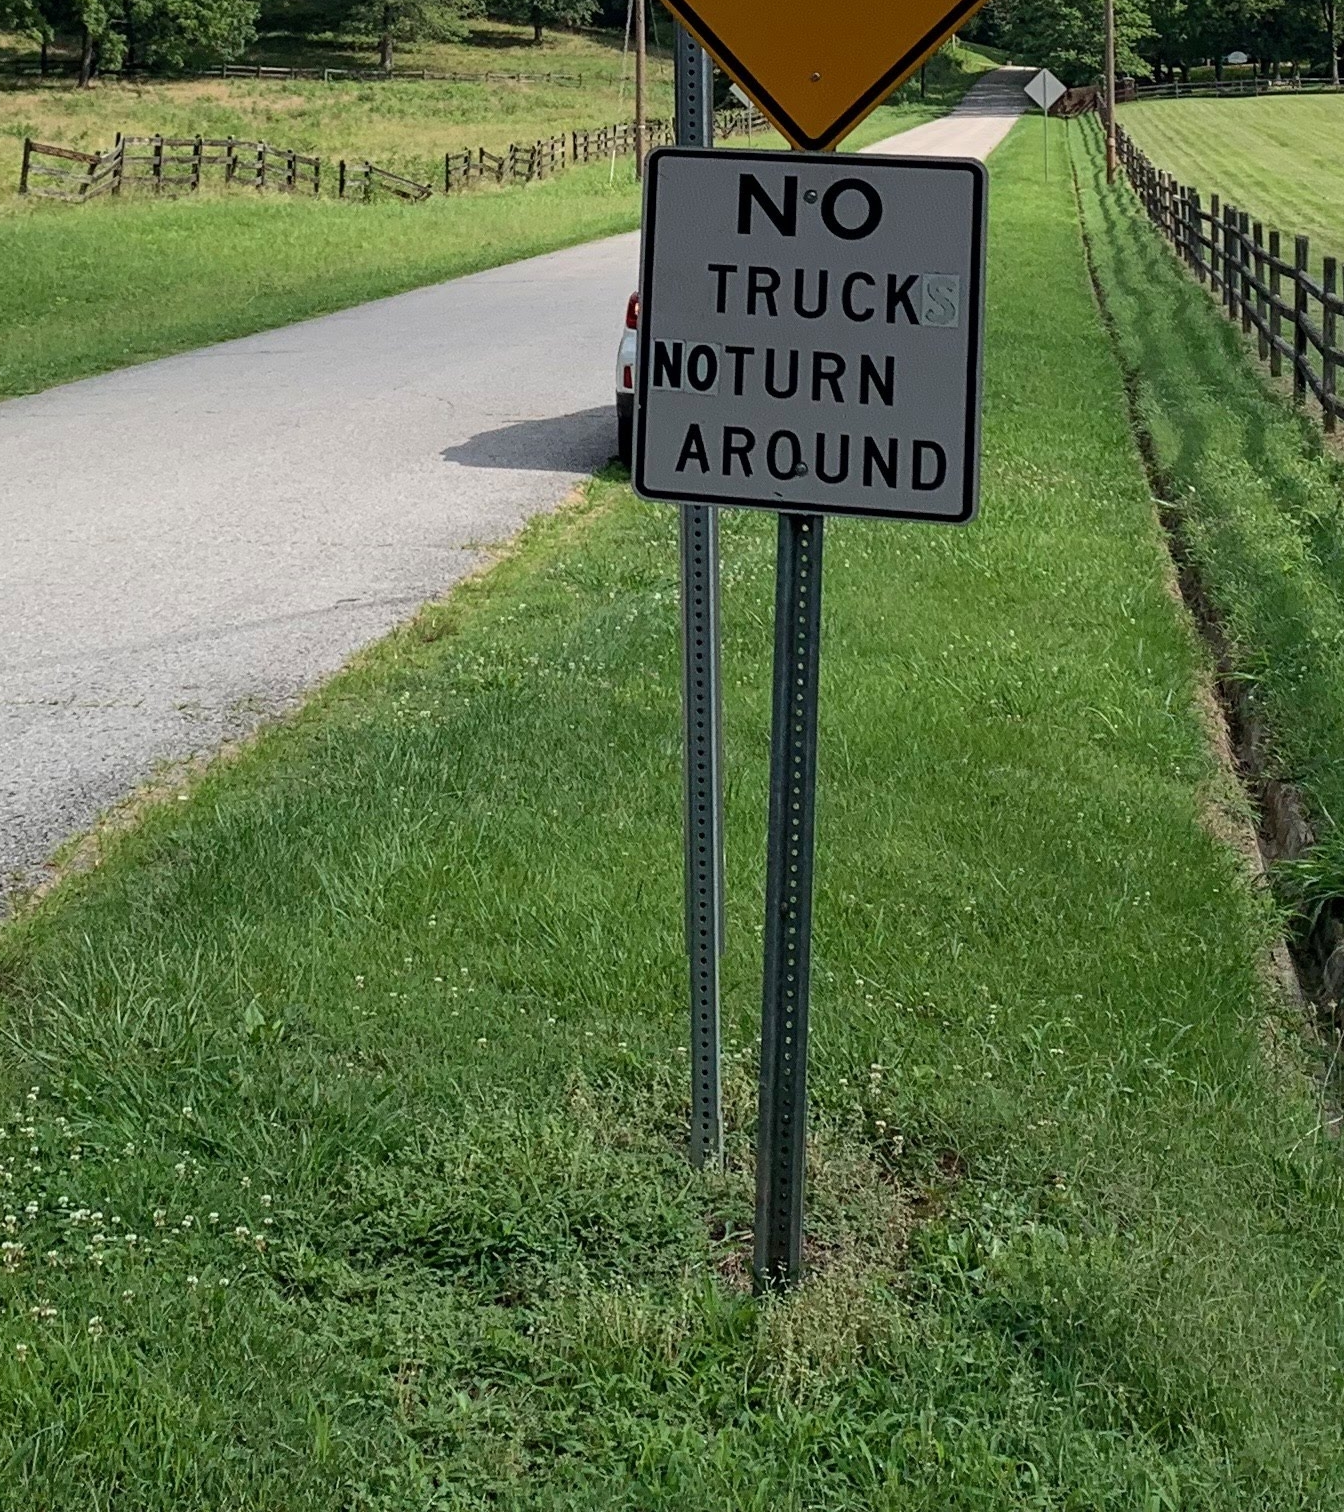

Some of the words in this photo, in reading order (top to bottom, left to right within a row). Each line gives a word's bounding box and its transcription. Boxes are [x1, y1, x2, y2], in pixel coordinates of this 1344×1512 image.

[737, 173, 884, 241] NO
[708, 263, 958, 326] TRUCKS
[674, 423, 948, 491] AROUND
